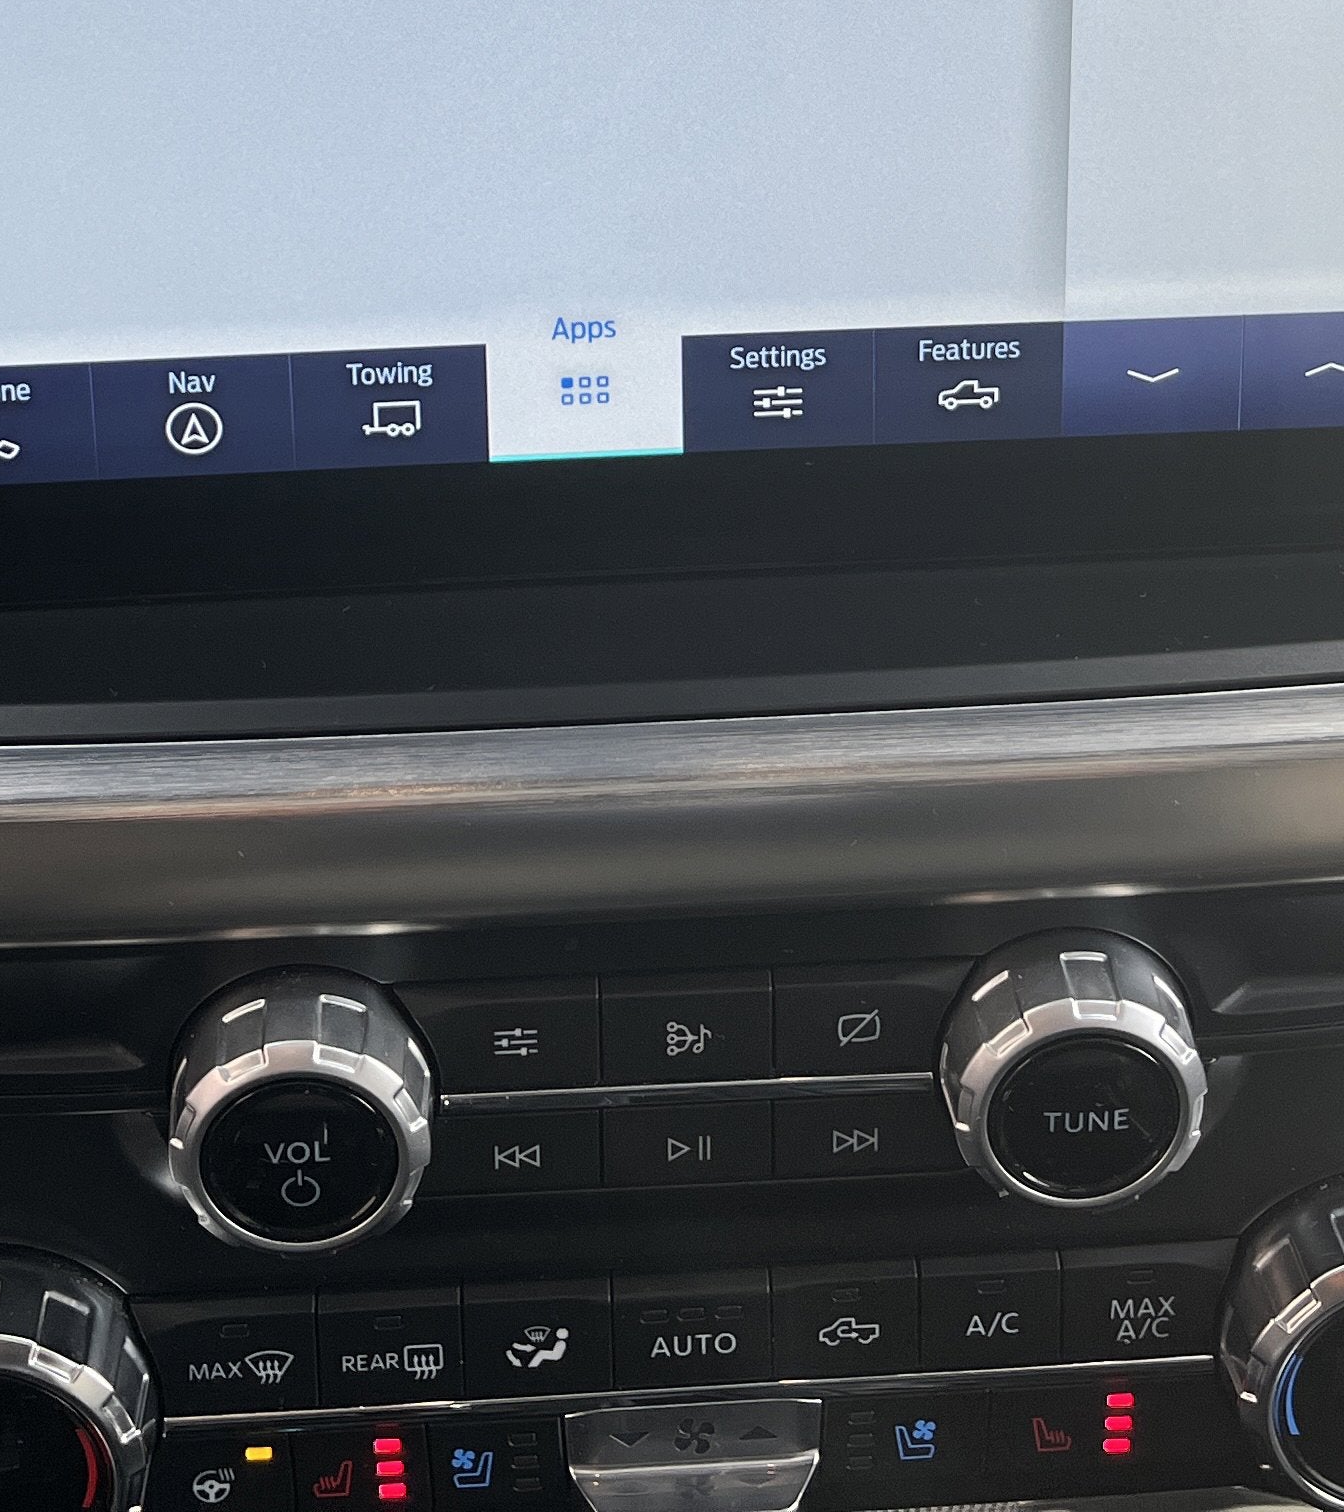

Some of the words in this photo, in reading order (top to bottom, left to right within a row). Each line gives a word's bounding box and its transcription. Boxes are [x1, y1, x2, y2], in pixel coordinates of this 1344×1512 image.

[551, 316, 617, 344] Apps
[730, 345, 827, 371] Settings
[919, 339, 1021, 362] Features
[168, 371, 216, 394] Nav
[345, 361, 433, 387] Towing
[1043, 1108, 1129, 1133] TUNE
[264, 1140, 331, 1164] VOL
[1110, 1296, 1175, 1320] MAX
[966, 1312, 1019, 1337] A/C
[1116, 1317, 1169, 1341] A/C
[651, 1332, 737, 1358] AUTO
[189, 1361, 243, 1381] MAX
[341, 1352, 399, 1372] REAR
